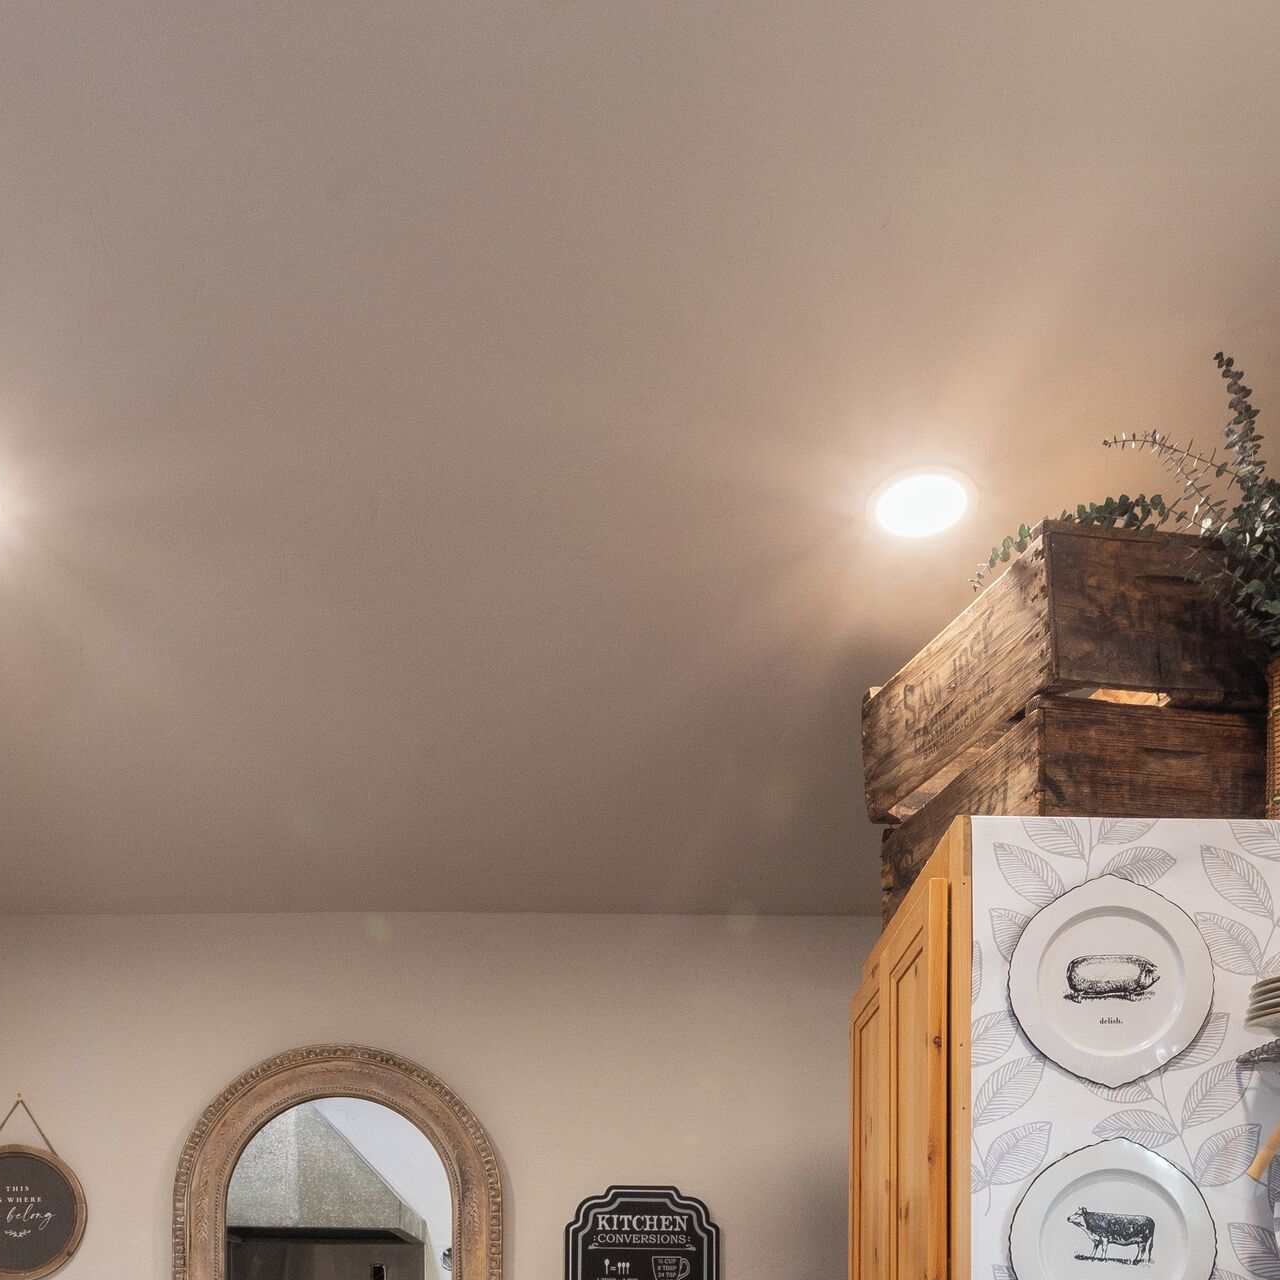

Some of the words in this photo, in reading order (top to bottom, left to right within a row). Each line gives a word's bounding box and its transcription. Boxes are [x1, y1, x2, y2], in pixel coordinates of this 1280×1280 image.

[1099, 1017, 1124, 1025] delish.
[6, 1203, 56, 1231] belong
[596, 1214, 688, 1231] KITCHEN
[597, 1233, 686, 1244] CONVERSIONS
